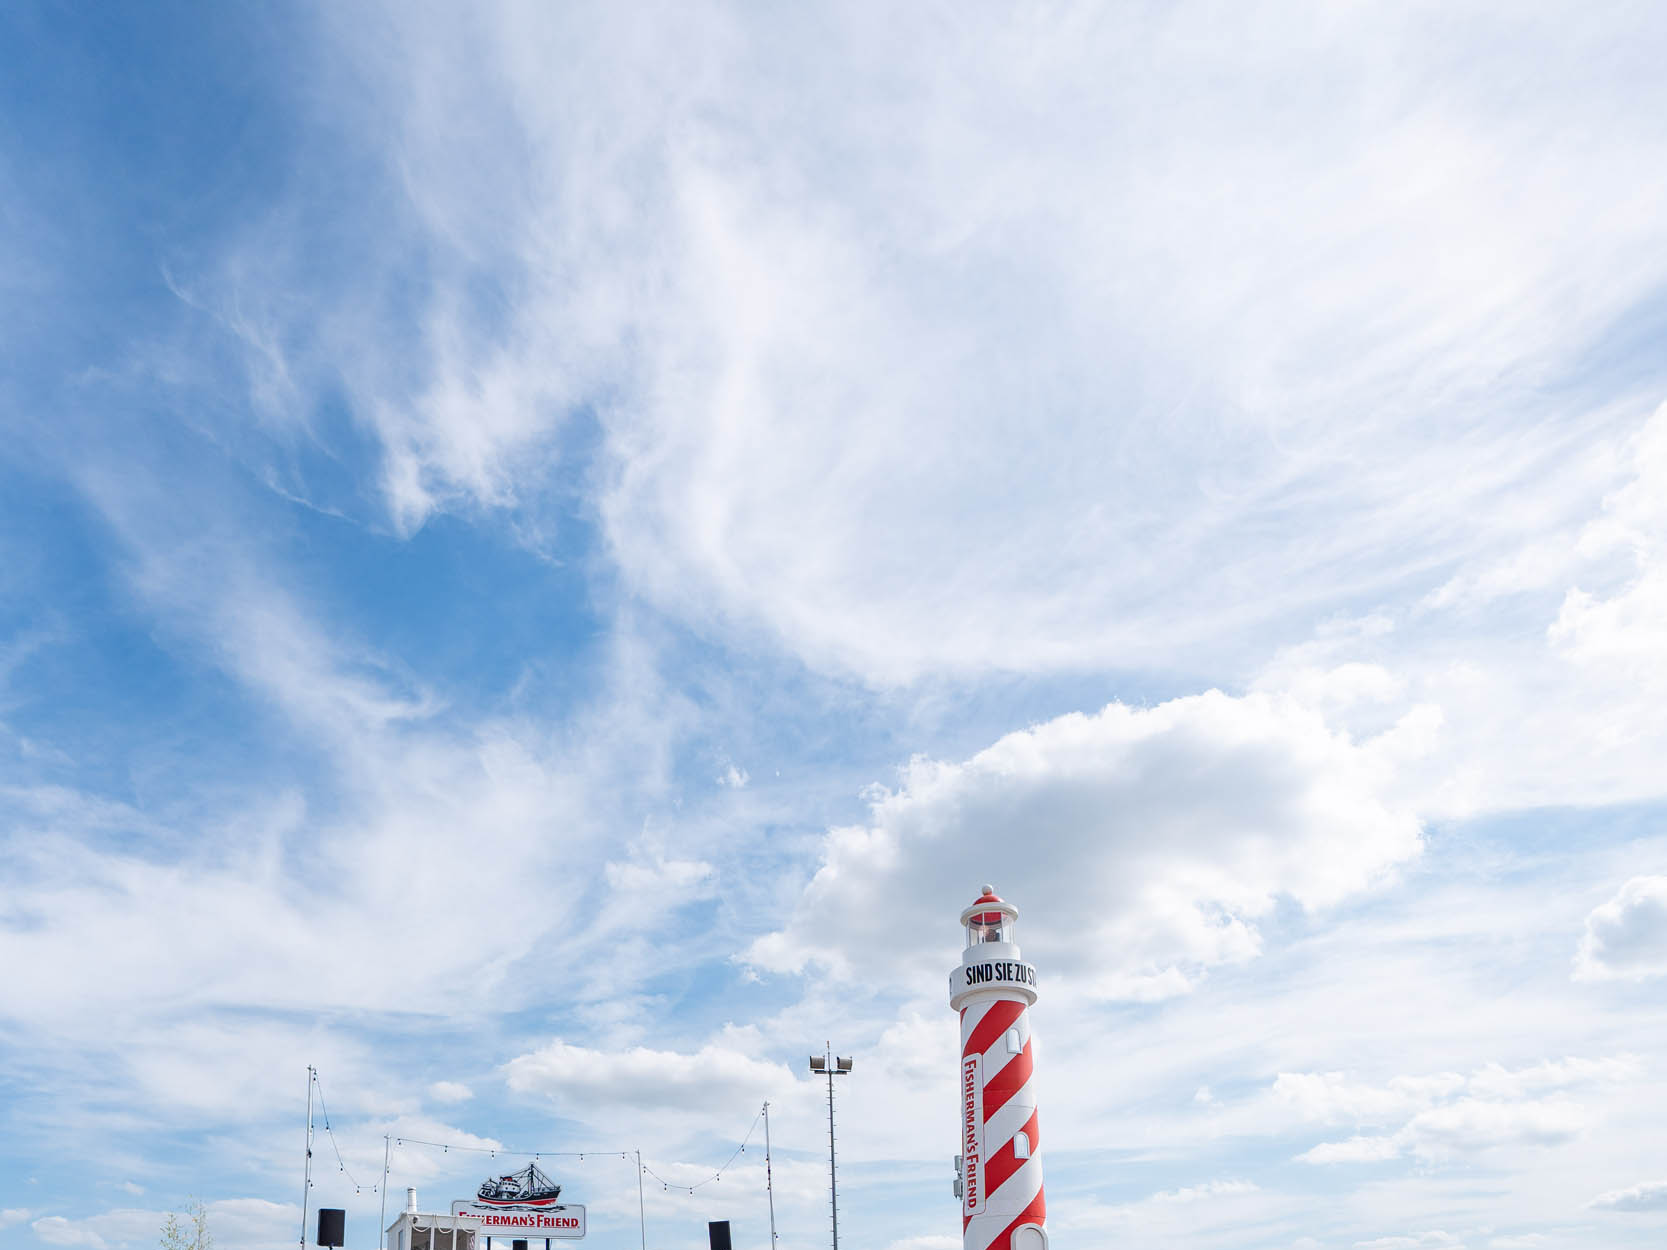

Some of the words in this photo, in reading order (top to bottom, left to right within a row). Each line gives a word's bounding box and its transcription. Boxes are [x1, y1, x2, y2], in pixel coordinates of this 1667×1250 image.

[966, 964, 993, 985] SIND
[995, 962, 1014, 981] SIE
[1015, 964, 1026, 983] ZU
[965, 1059, 977, 1153] FISHERMAN'S
[966, 1154, 979, 1209] FRIEND
[537, 1214, 579, 1228] FRIEND
